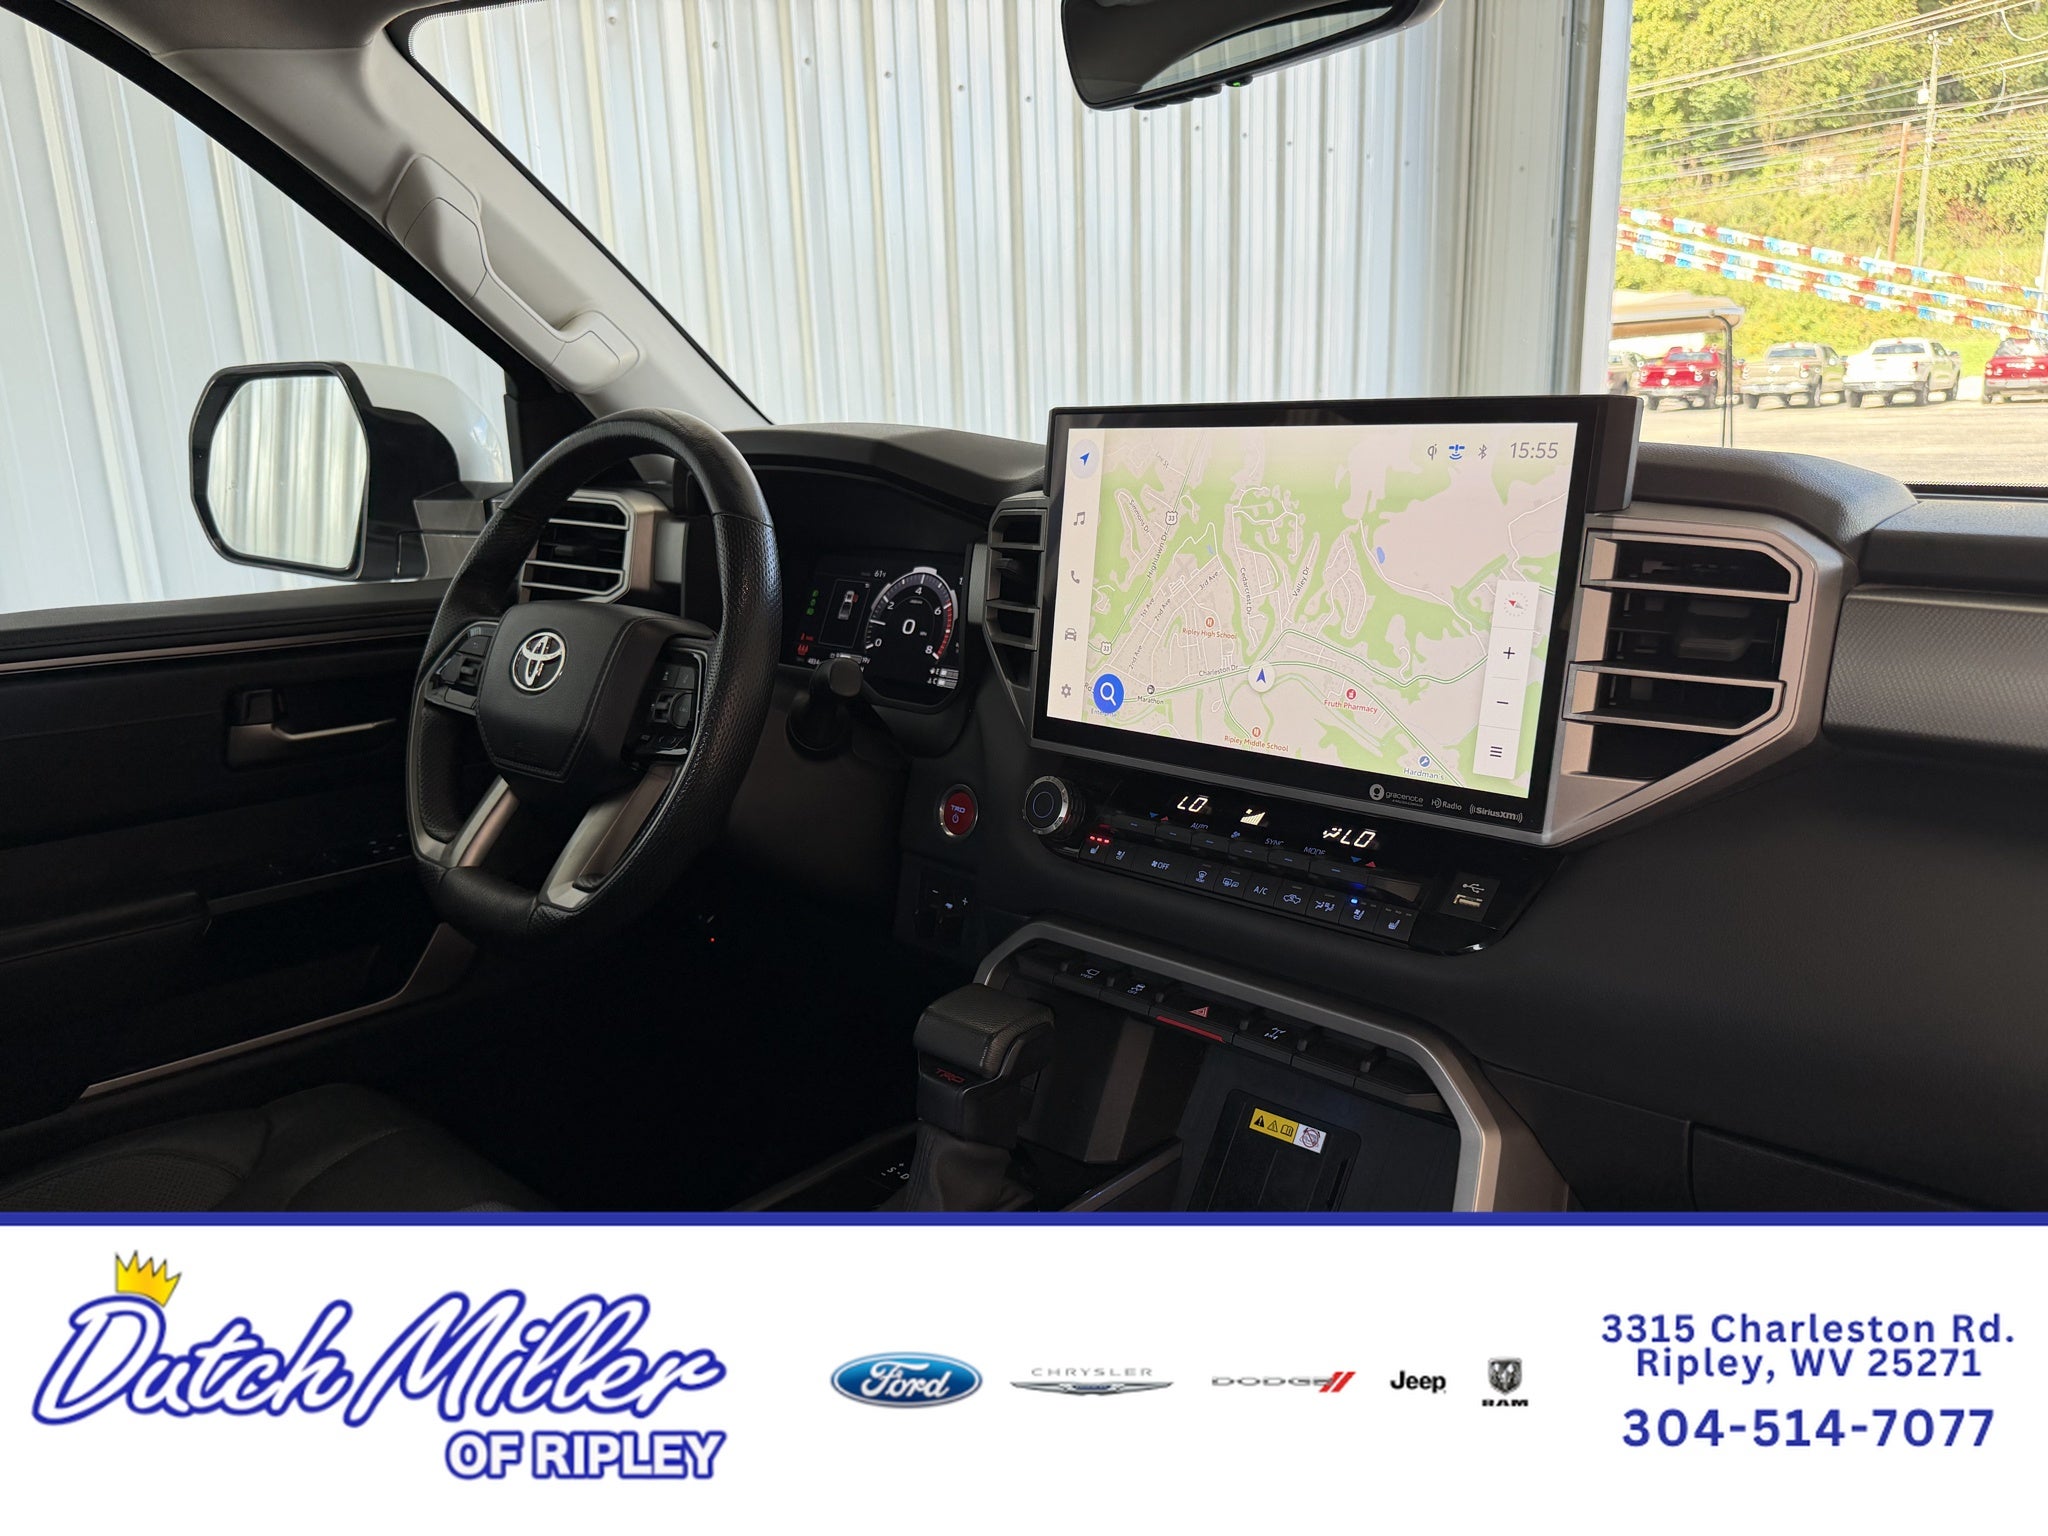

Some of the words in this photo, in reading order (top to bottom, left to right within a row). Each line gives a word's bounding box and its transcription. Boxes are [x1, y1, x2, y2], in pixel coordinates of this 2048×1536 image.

[1510, 441, 1559, 459] 15:55
[1128, 499, 1145, 525] Simmons
[1147, 542, 1165, 579] Highlawn
[1199, 578, 1210, 591] 3rd
[1208, 570, 1219, 582] Ave
[1292, 576, 1307, 597] Valley
[1302, 566, 1310, 575] Dr
[915, 587, 922, 595] 4
[1240, 567, 1251, 605] Cedarcrest
[1246, 606, 1252, 615] Dr
[887, 602, 894, 610] 2
[1140, 609, 1148, 618] 1st
[1146, 598, 1155, 610] Ave
[1154, 608, 1164, 621] 2nd
[1161, 598, 1171, 610] Ave
[902, 618, 916, 635] 0
[1182, 627, 1200, 637] Ripley
[1217, 632, 1237, 640] School
[875, 638, 883, 647] 0
[925, 645, 933, 654] 8
[1128, 656, 1138, 669] 2nd
[1134, 645, 1143, 658] Ave
[1198, 667, 1229, 677] Charleston
[1137, 695, 1164, 705] Marathon
[1323, 699, 1343, 709] Fruth
[1343, 701, 1378, 714] Pharmacy
[1224, 735, 1243, 746] Ripley
[1244, 738, 1265, 749] Middle
[1267, 742, 1289, 752] School
[1403, 767, 1445, 781] Hardman's
[1385, 790, 1424, 804] gracenote
[950, 804, 966, 814] TRD
[1442, 800, 1462, 811] Radio
[1157, 861, 1171, 871] OFF
[1253, 885, 1269, 896] A/C
[936, 1067, 965, 1084] TRD
